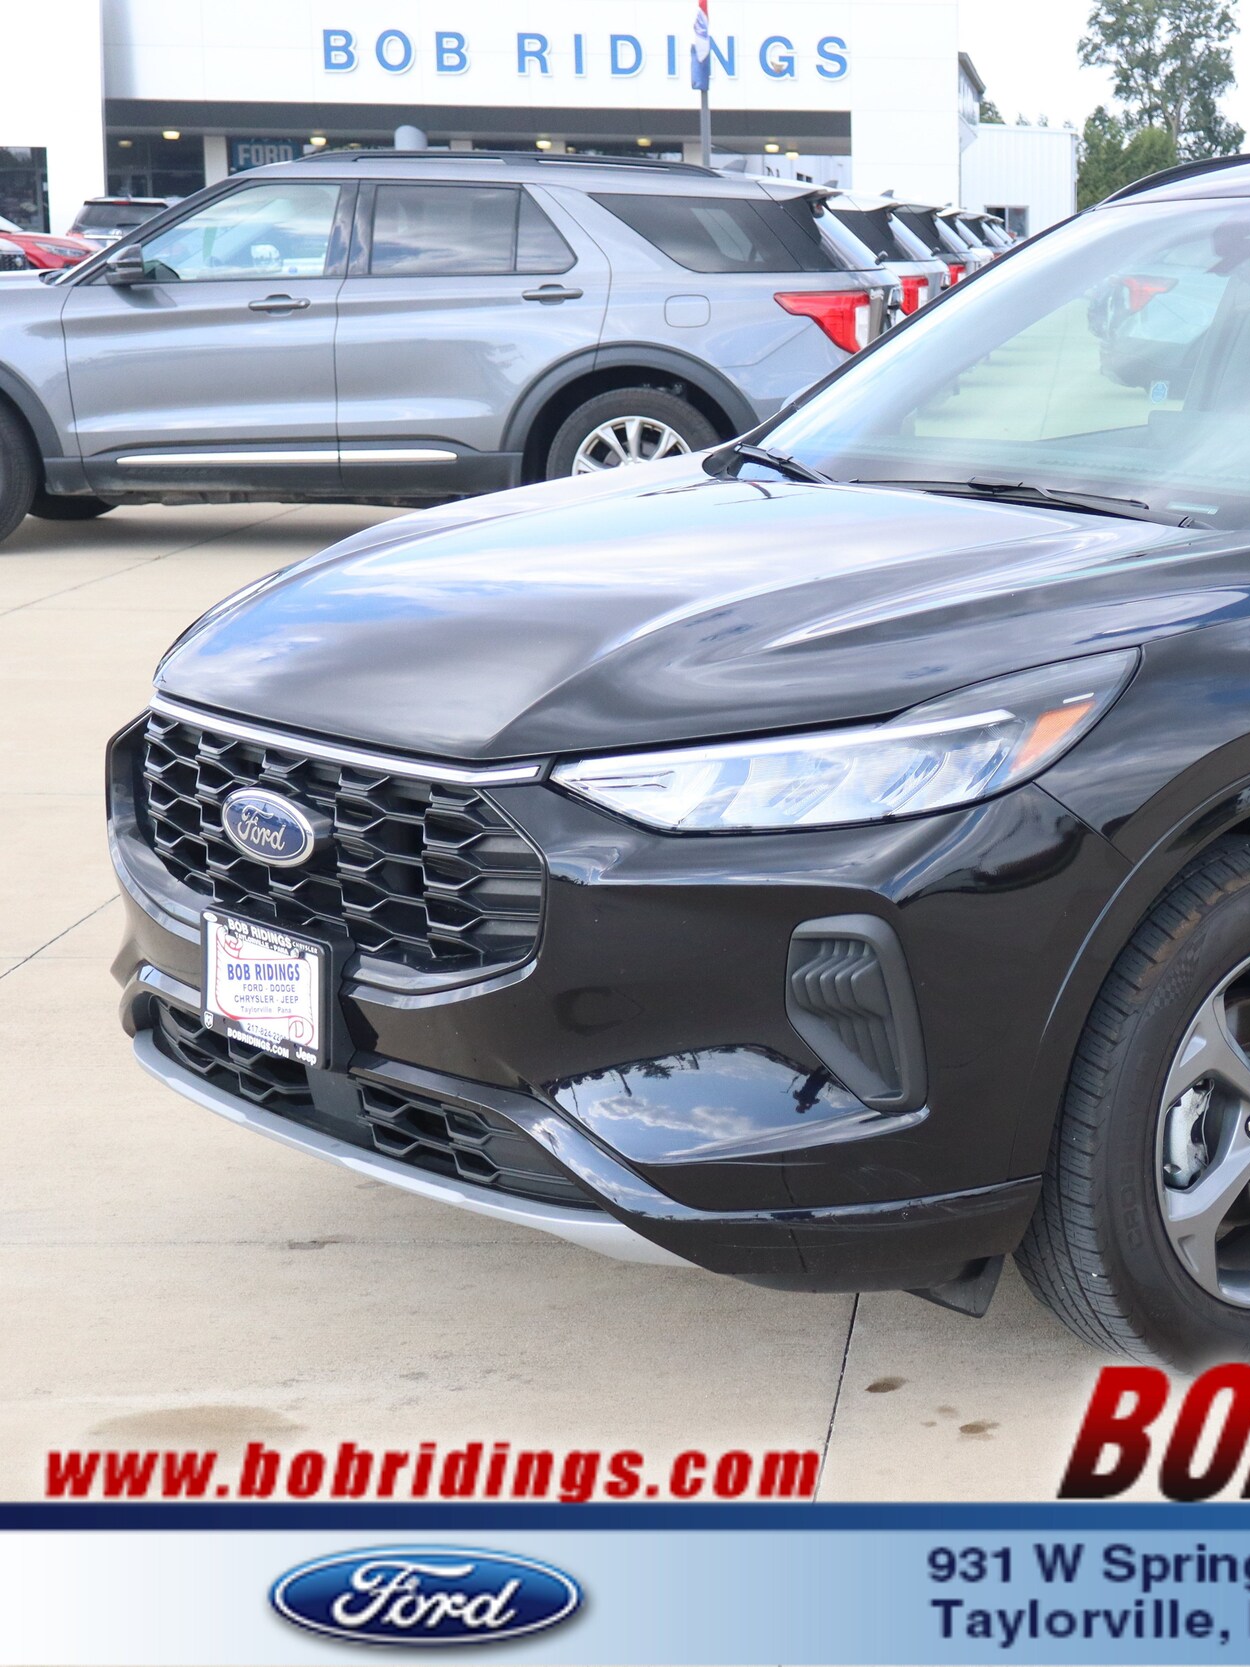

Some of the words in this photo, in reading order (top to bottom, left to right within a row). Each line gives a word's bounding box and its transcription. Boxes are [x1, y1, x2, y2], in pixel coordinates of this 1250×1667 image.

[322, 28, 471, 75] BOB
[516, 31, 850, 79] RIDINGS
[237, 143, 293, 166] FORD
[237, 804, 286, 851] Ford
[227, 918, 249, 935] BOB
[250, 926, 293, 949] RIDINGS
[227, 963, 251, 981] BOB
[254, 963, 301, 981] RIDINGS
[234, 994, 275, 1004] CHRYSLER
[280, 995, 299, 1004] JEEP
[242, 983, 264, 993] FORD
[269, 983, 296, 993] DODGE
[226, 1026, 290, 1059] BOBRIDINGS.COM
[246, 1022, 288, 1044] 217-824-22
[295, 1046, 317, 1066] Jeep
